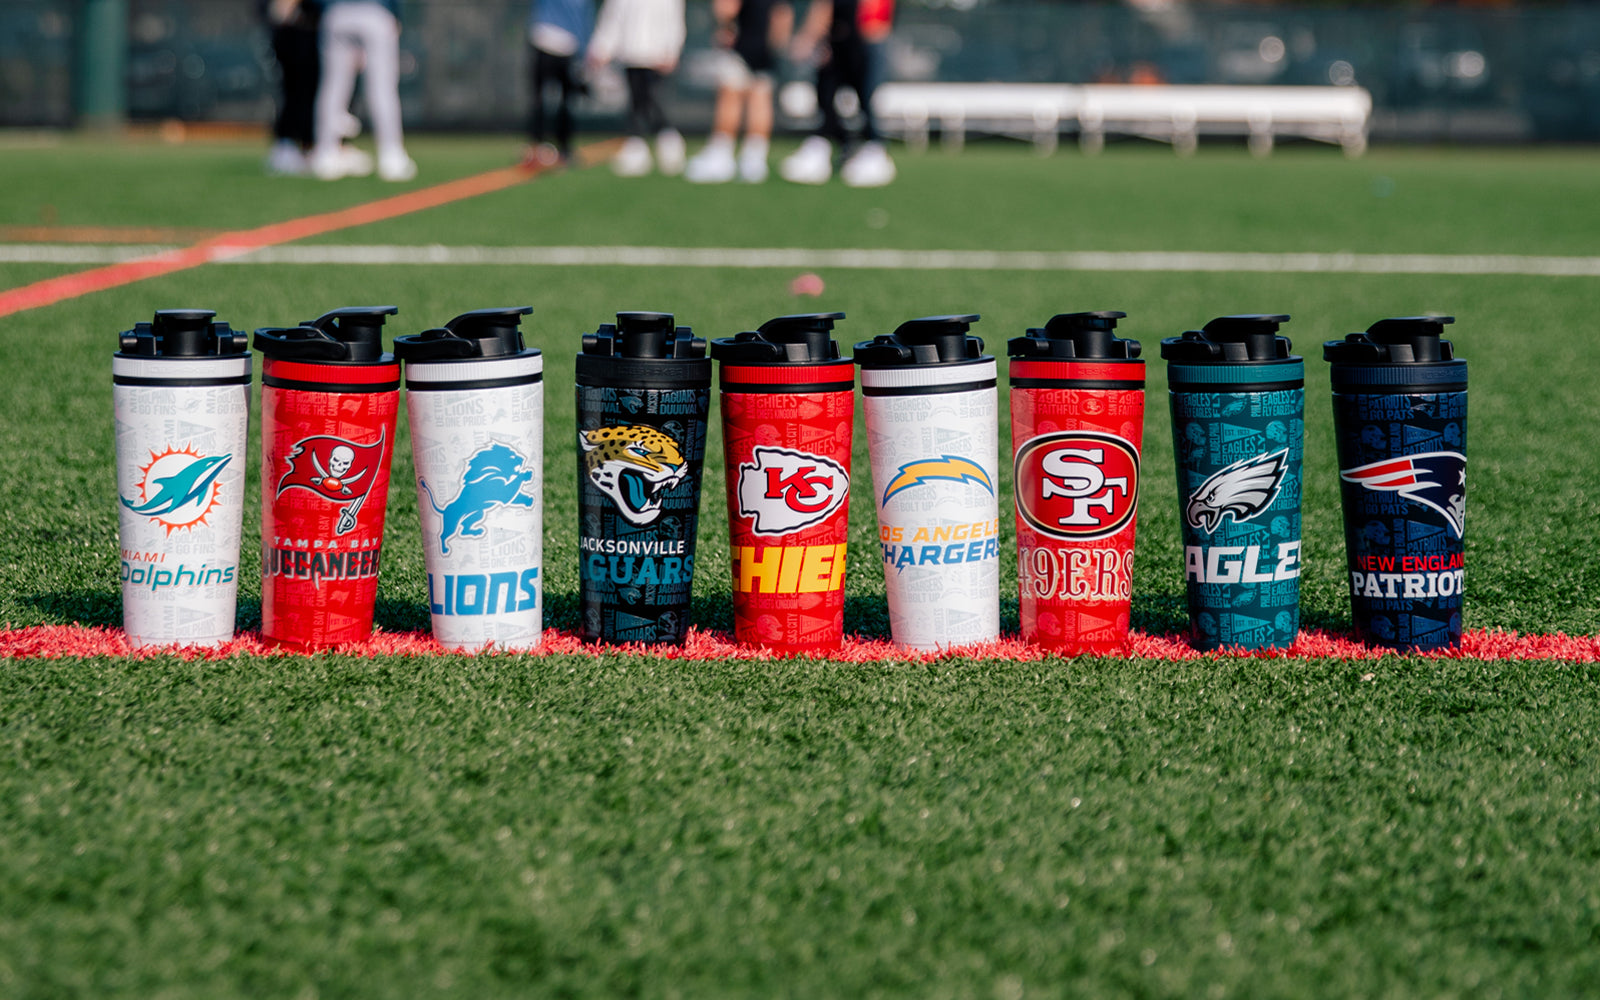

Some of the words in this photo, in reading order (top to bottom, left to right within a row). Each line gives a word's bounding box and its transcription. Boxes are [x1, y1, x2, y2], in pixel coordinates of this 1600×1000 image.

[1038, 390, 1079, 404] 49ERS
[444, 398, 484, 416] LIONS
[1222, 436, 1256, 454] EAGLES
[764, 466, 834, 513] KC
[1042, 448, 1127, 526] SF
[274, 536, 338, 549] TAMPA
[350, 537, 378, 549] BAY
[879, 525, 904, 542] OS
[580, 536, 685, 555] JACKSONVILLE
[121, 549, 165, 563] MIAMI
[1185, 539, 1302, 584] AGLE
[1357, 555, 1395, 571] NEW
[121, 561, 235, 592] Dolphins
[1018, 546, 1135, 601] 49ERS
[428, 566, 539, 616] LIONS
